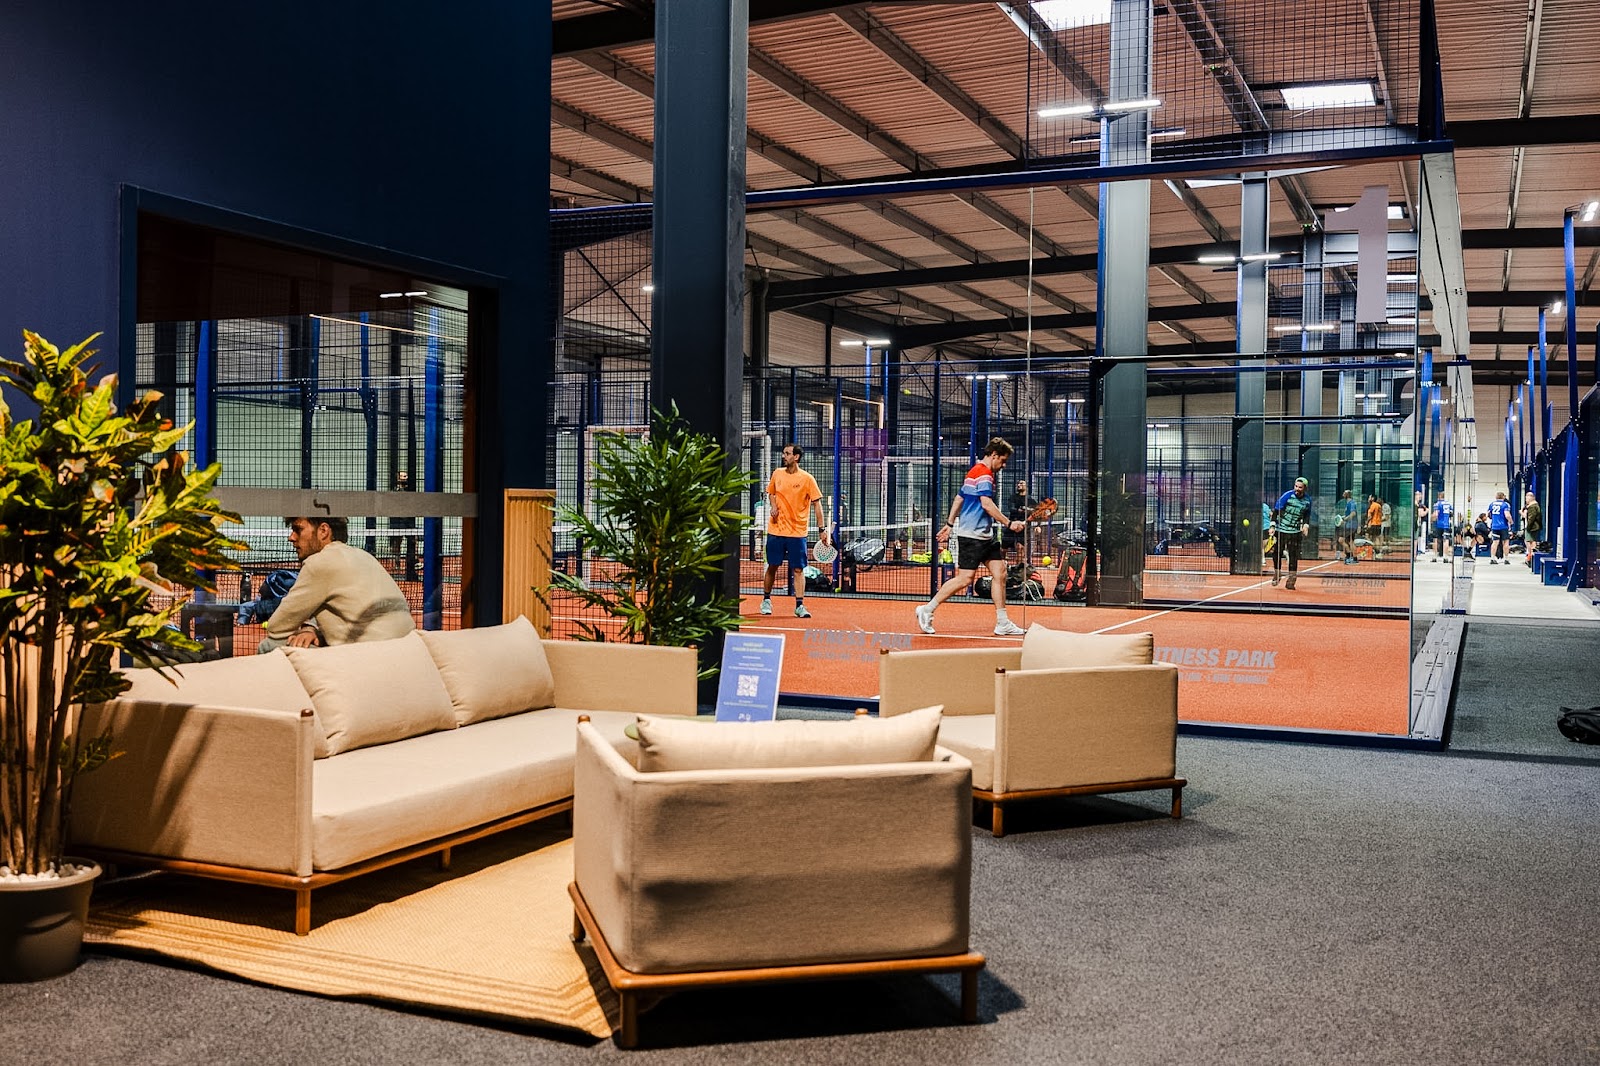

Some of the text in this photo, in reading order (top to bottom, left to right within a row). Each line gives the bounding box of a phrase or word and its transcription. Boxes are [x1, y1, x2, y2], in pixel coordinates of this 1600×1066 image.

[1325, 185, 1388, 323] 1
[1492, 505, 1501, 514] 22
[1321, 578, 1386, 588] FITNESS PARK
[803, 628, 913, 649] FITNESS PARK
[1153, 646, 1278, 668] ITNESS PARK
